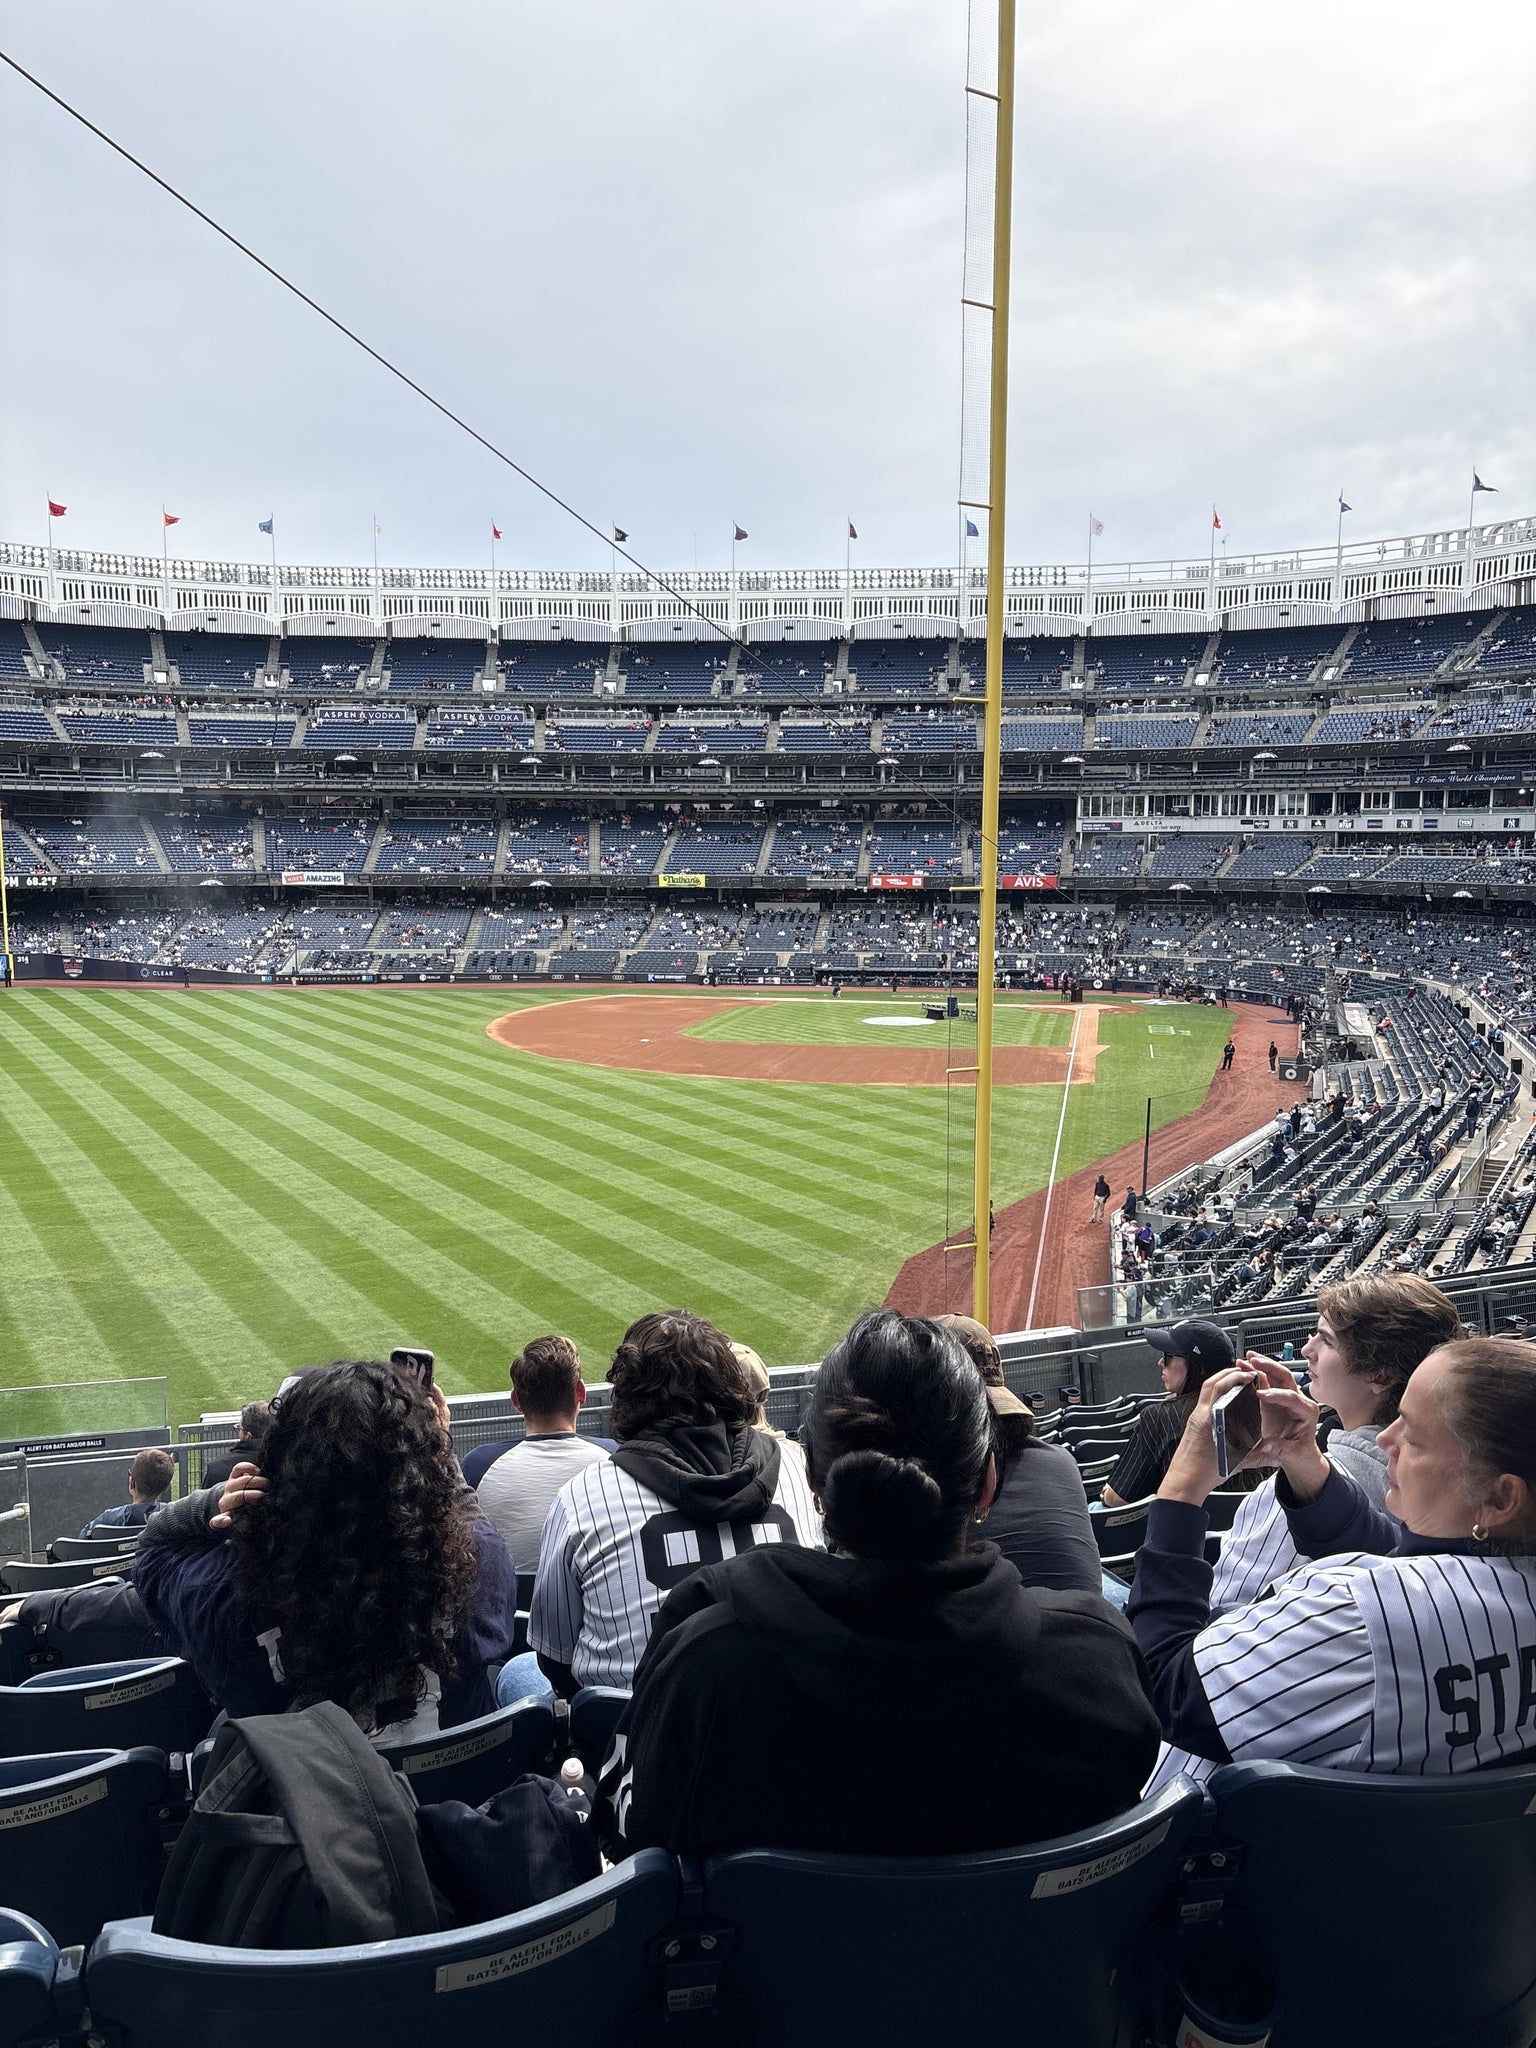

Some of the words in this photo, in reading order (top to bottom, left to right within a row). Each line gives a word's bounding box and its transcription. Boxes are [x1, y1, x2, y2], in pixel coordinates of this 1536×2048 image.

[1448, 774, 1473, 782] World
[1474, 774, 1516, 783] Champions
[26, 876, 58, 886] 68.2°F
[1014, 876, 1044, 887] AVIS
[117, 1691, 143, 1702] AND/OR
[144, 1683, 163, 1694] BALLS
[120, 1688, 138, 1697] ALERT
[421, 1760, 441, 1768] BATS
[443, 1749, 474, 1763] AND/OR
[475, 1738, 497, 1752] BALLS
[447, 1744, 470, 1756] ALERT
[472, 1738, 485, 1746] FOR
[0, 1816, 22, 1825] BATS
[24, 1806, 60, 1820] AND/OR
[63, 1794, 89, 1810] BALLS
[28, 1801, 54, 1812] ALERT
[57, 1795, 73, 1805] FOR
[1058, 1877, 1085, 1890] BATS
[1085, 1862, 1124, 1881] AND/OR
[1127, 1842, 1151, 1863] BALLS
[1078, 1866, 1093, 1877] BE
[1094, 1851, 1122, 1870] ALERT
[1125, 1843, 1141, 1857] FOR
[466, 1969, 499, 1983] BATS
[502, 1950, 552, 1973] AND/OR
[556, 1928, 590, 1953] BALLS
[490, 1958, 505, 1968] BE
[510, 1942, 546, 1961] ALERT
[550, 1931, 572, 1946] FOR
